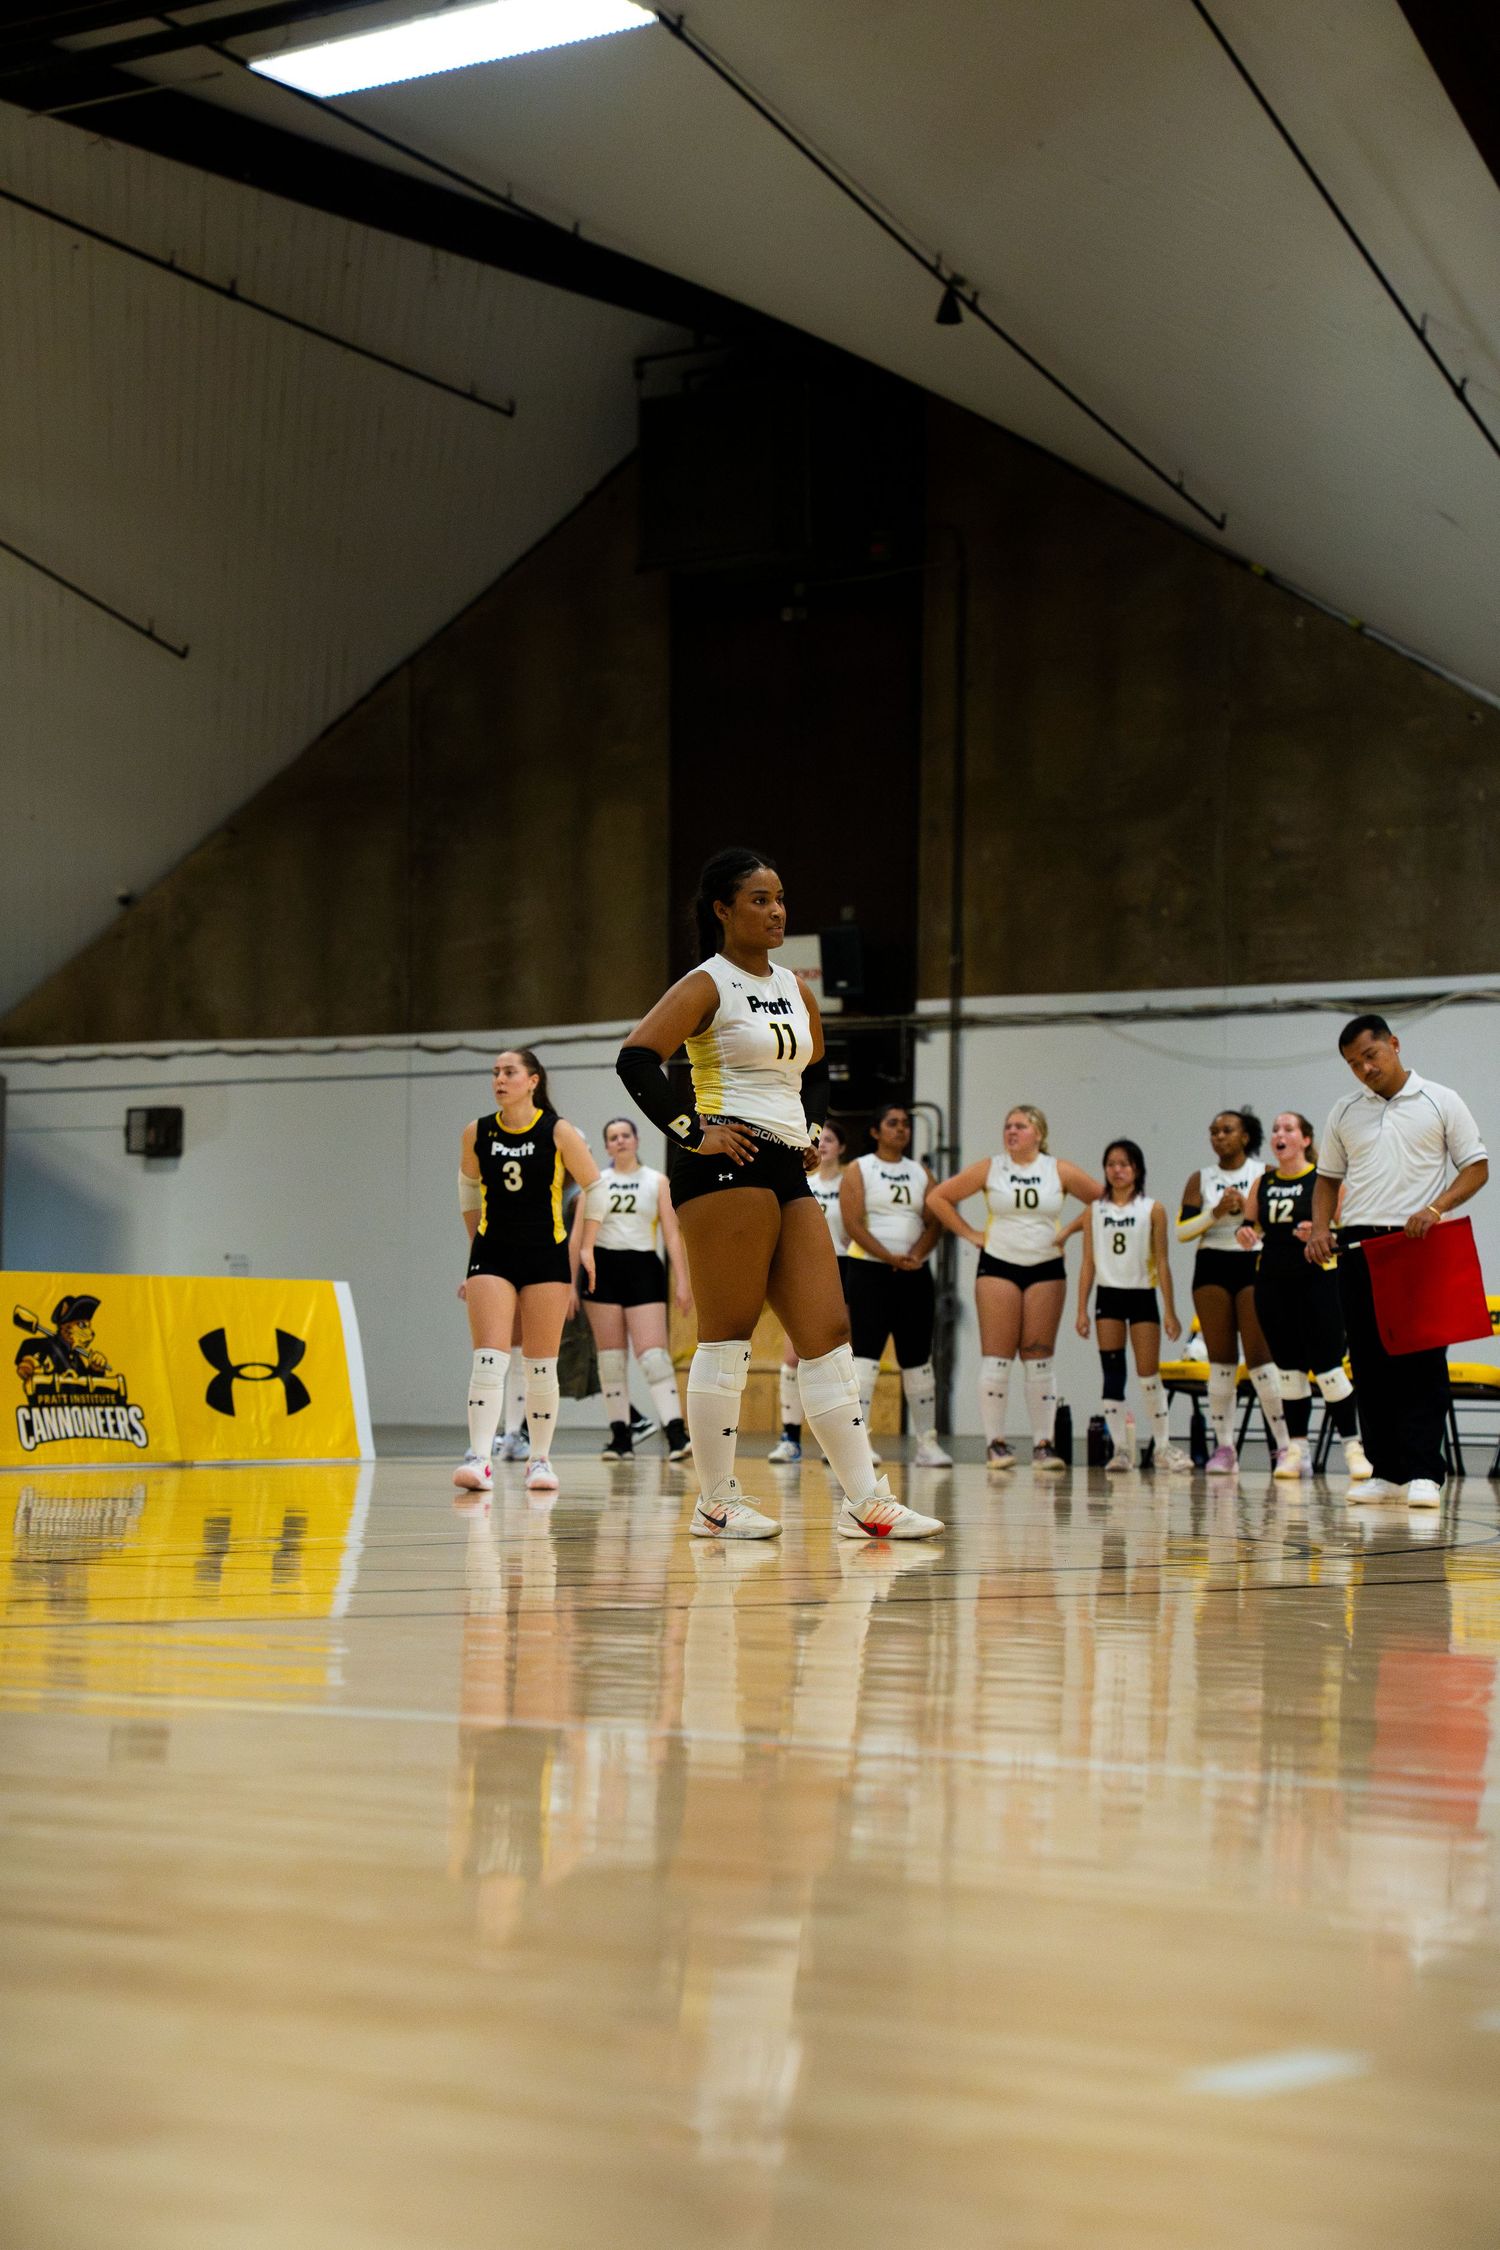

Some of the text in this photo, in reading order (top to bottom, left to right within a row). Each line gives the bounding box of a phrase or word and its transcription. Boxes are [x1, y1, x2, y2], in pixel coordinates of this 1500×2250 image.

[746, 995, 795, 1015] Pratt
[769, 1022, 798, 1061] 11
[668, 1114, 692, 1139] P
[491, 1141, 535, 1157] Pratt
[502, 1160, 524, 1193] 3
[609, 1182, 639, 1191] Pratt
[881, 1172, 910, 1182] Pratt
[1010, 1174, 1042, 1186] Pratt
[890, 1184, 912, 1206] 21
[1014, 1187, 1040, 1210] 10
[1266, 1184, 1304, 1198] Pratt
[610, 1194, 637, 1215] 22
[1267, 1198, 1295, 1224] 12
[1103, 1215, 1136, 1229] Pratt
[1113, 1232, 1127, 1256] 8
[37, 1394, 117, 1405] PRATT INSTITUTE
[16, 1406, 148, 1451] CANNONEERS
